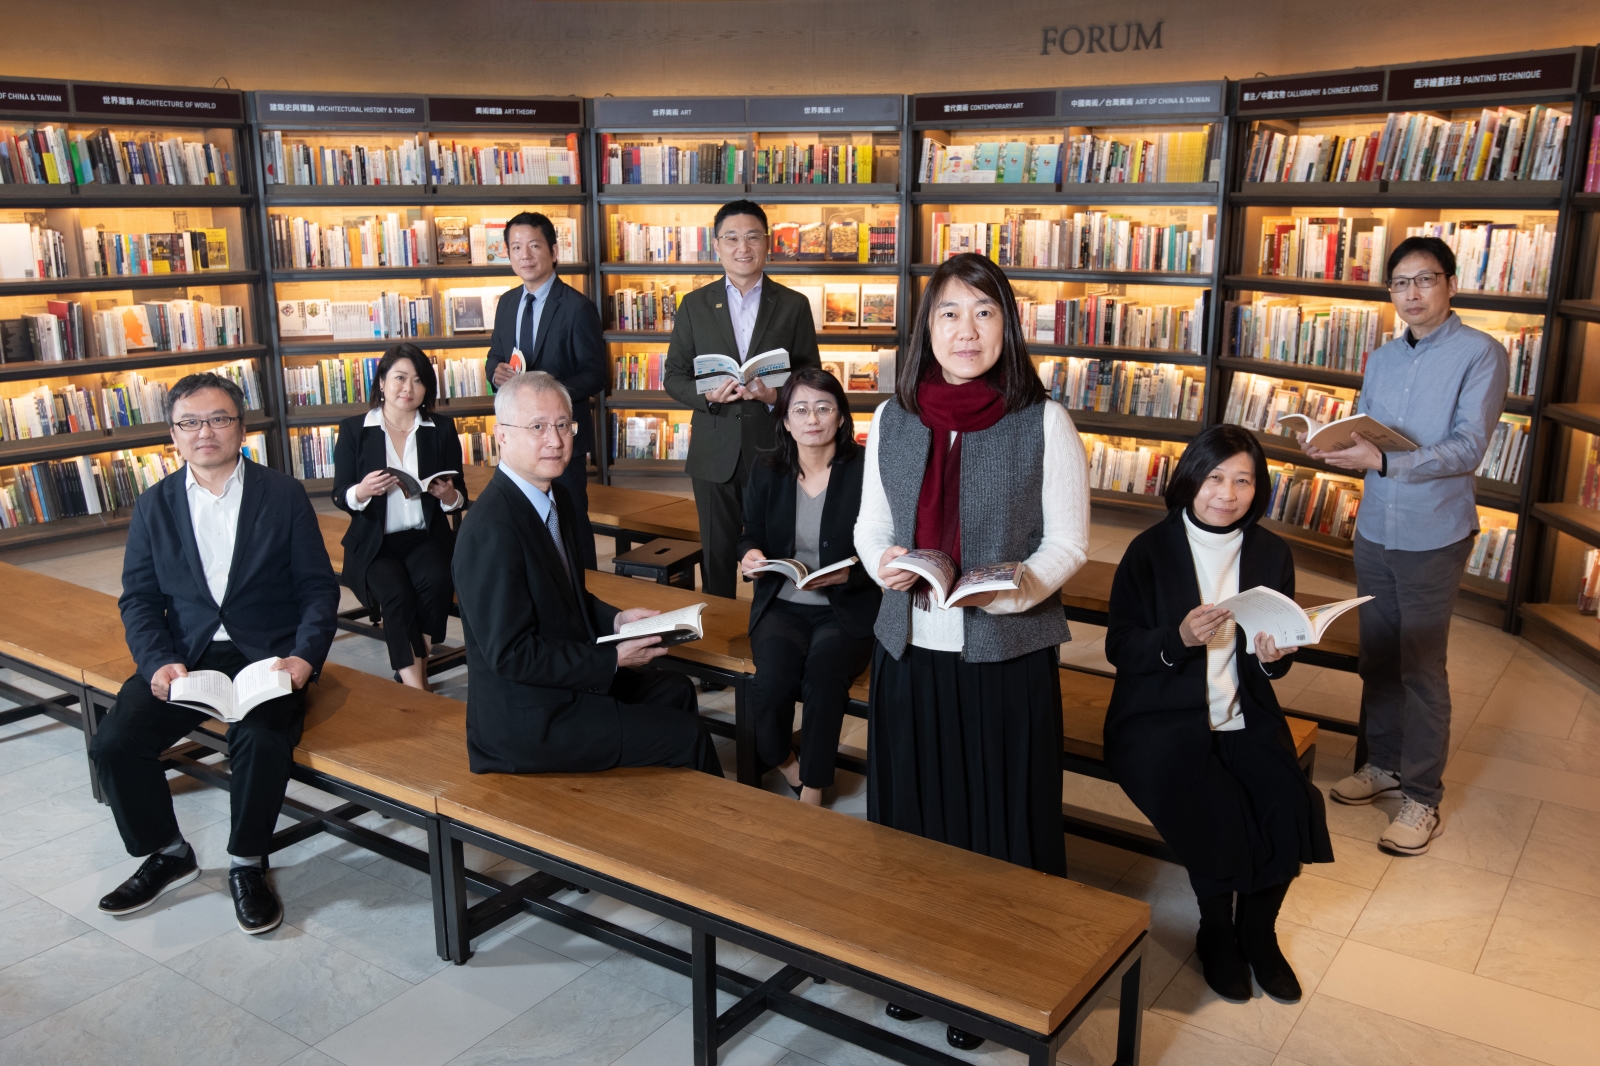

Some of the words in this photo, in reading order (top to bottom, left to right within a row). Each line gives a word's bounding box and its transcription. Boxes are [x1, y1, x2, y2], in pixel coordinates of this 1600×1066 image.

[1040, 21, 1165, 56] FORUM
[1463, 74, 1497, 84] PAINTING
[1498, 70, 1542, 81] TECHNIQUE
[1287, 89, 1320, 98] CALLIGRAPHY
[1328, 86, 1350, 94] CHINESE
[1351, 84, 1378, 93] ANTIQUES
[102, 96, 134, 106] 世界建築
[136, 99, 184, 108] ARCHITECTURE
